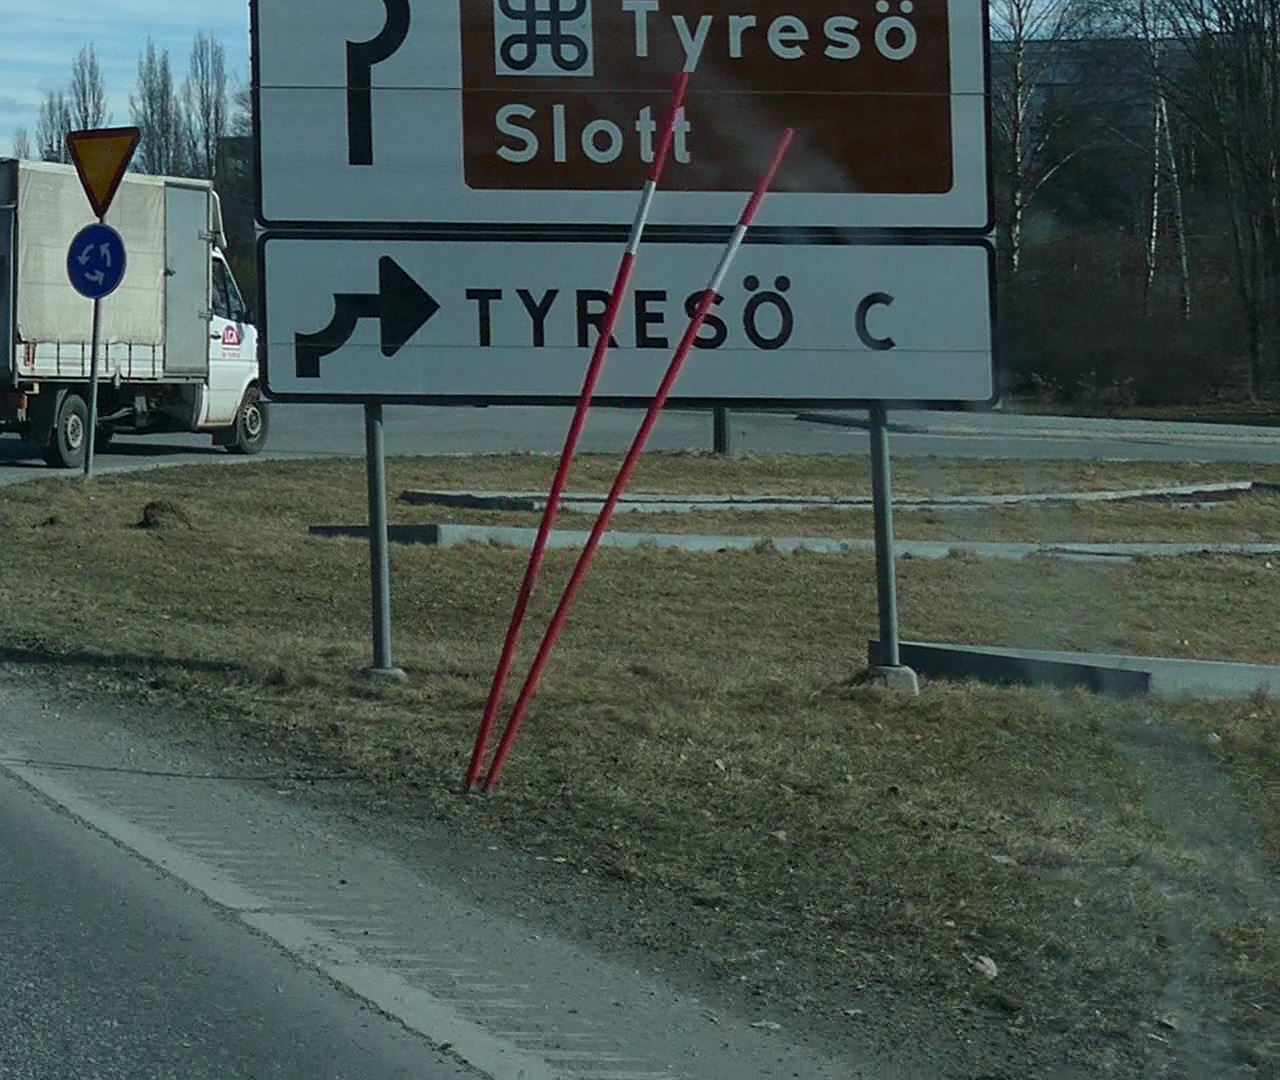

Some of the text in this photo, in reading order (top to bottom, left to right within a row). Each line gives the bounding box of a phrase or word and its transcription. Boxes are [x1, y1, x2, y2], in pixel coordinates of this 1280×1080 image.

[622, 0, 917, 73] Tyresö
[495, 103, 690, 164] Slott
[465, 275, 896, 351] TYRESÖ C
